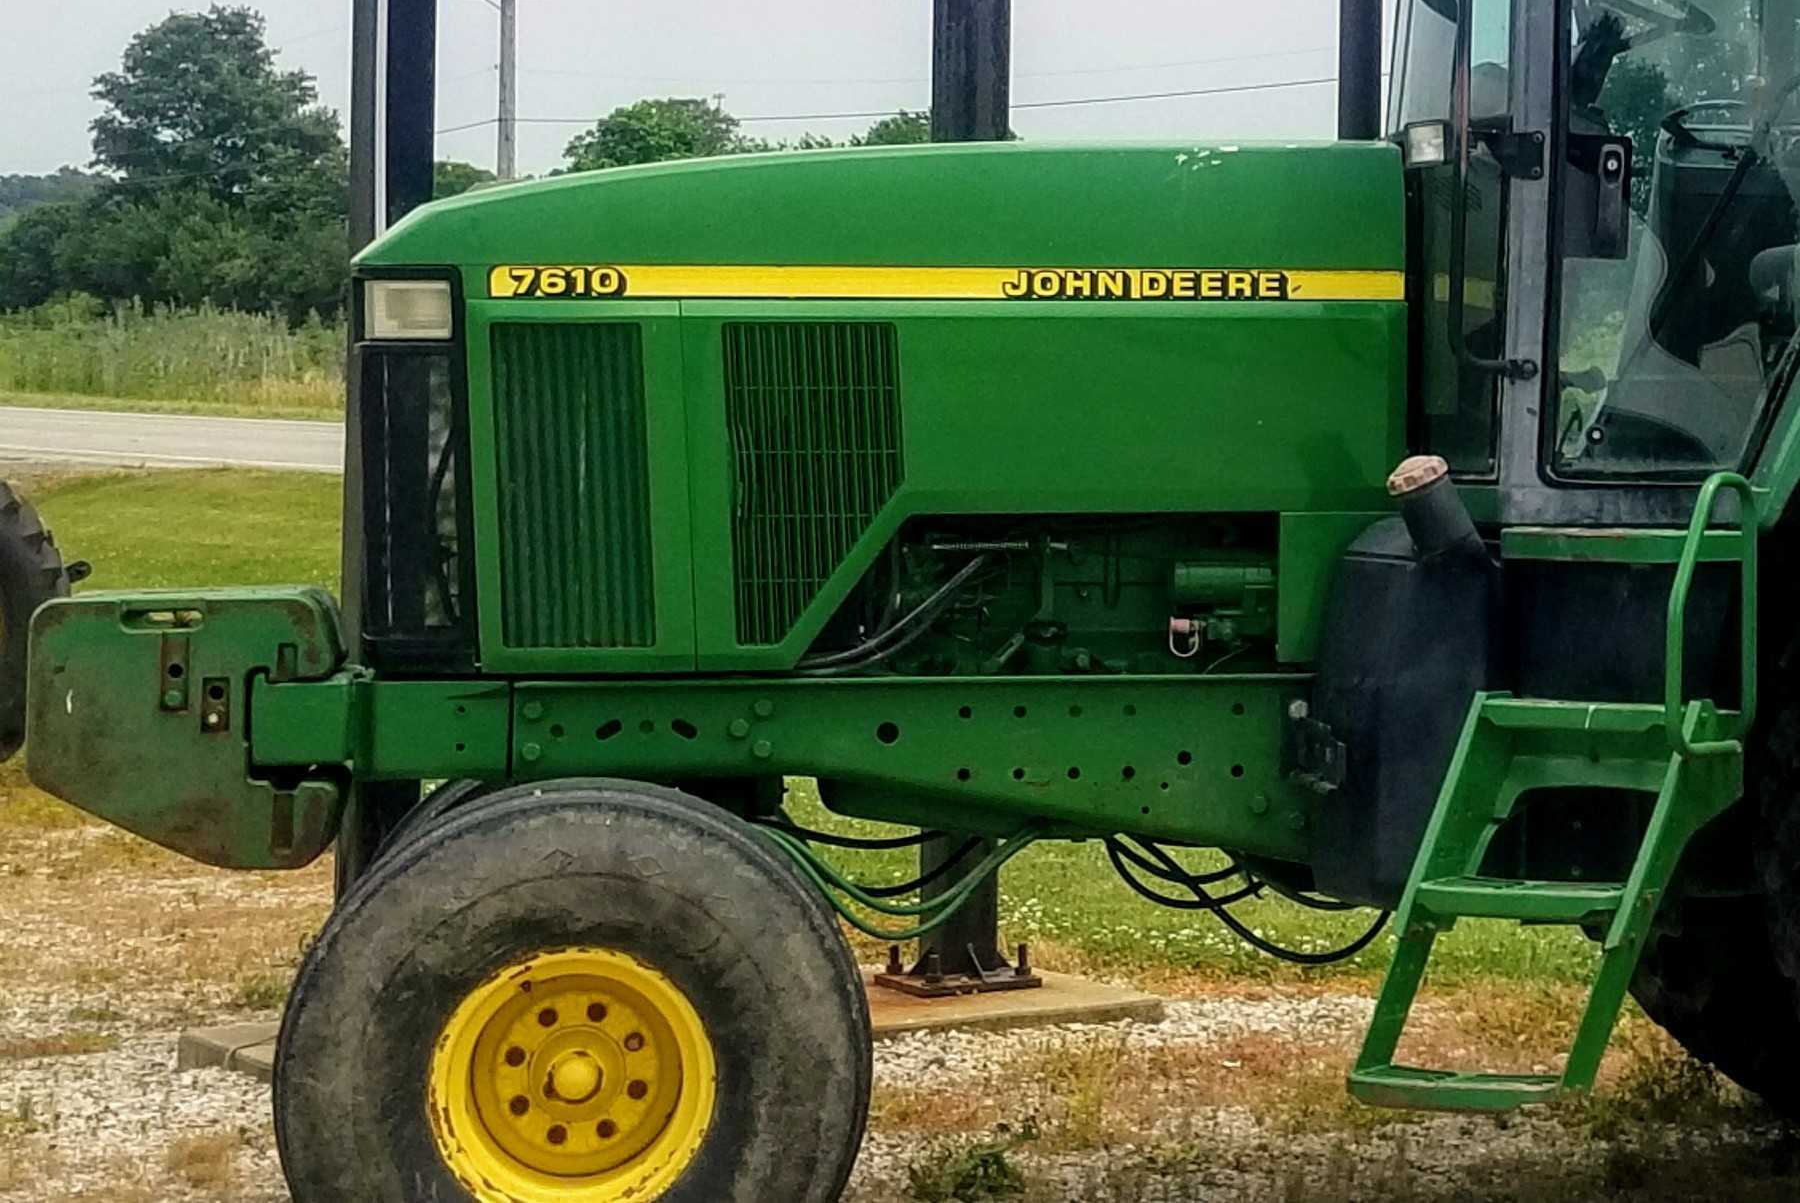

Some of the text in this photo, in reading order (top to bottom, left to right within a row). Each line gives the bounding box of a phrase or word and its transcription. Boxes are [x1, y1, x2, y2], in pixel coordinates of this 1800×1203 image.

[509, 267, 626, 297] 7610
[1002, 270, 1290, 299] JOHN DEERE
